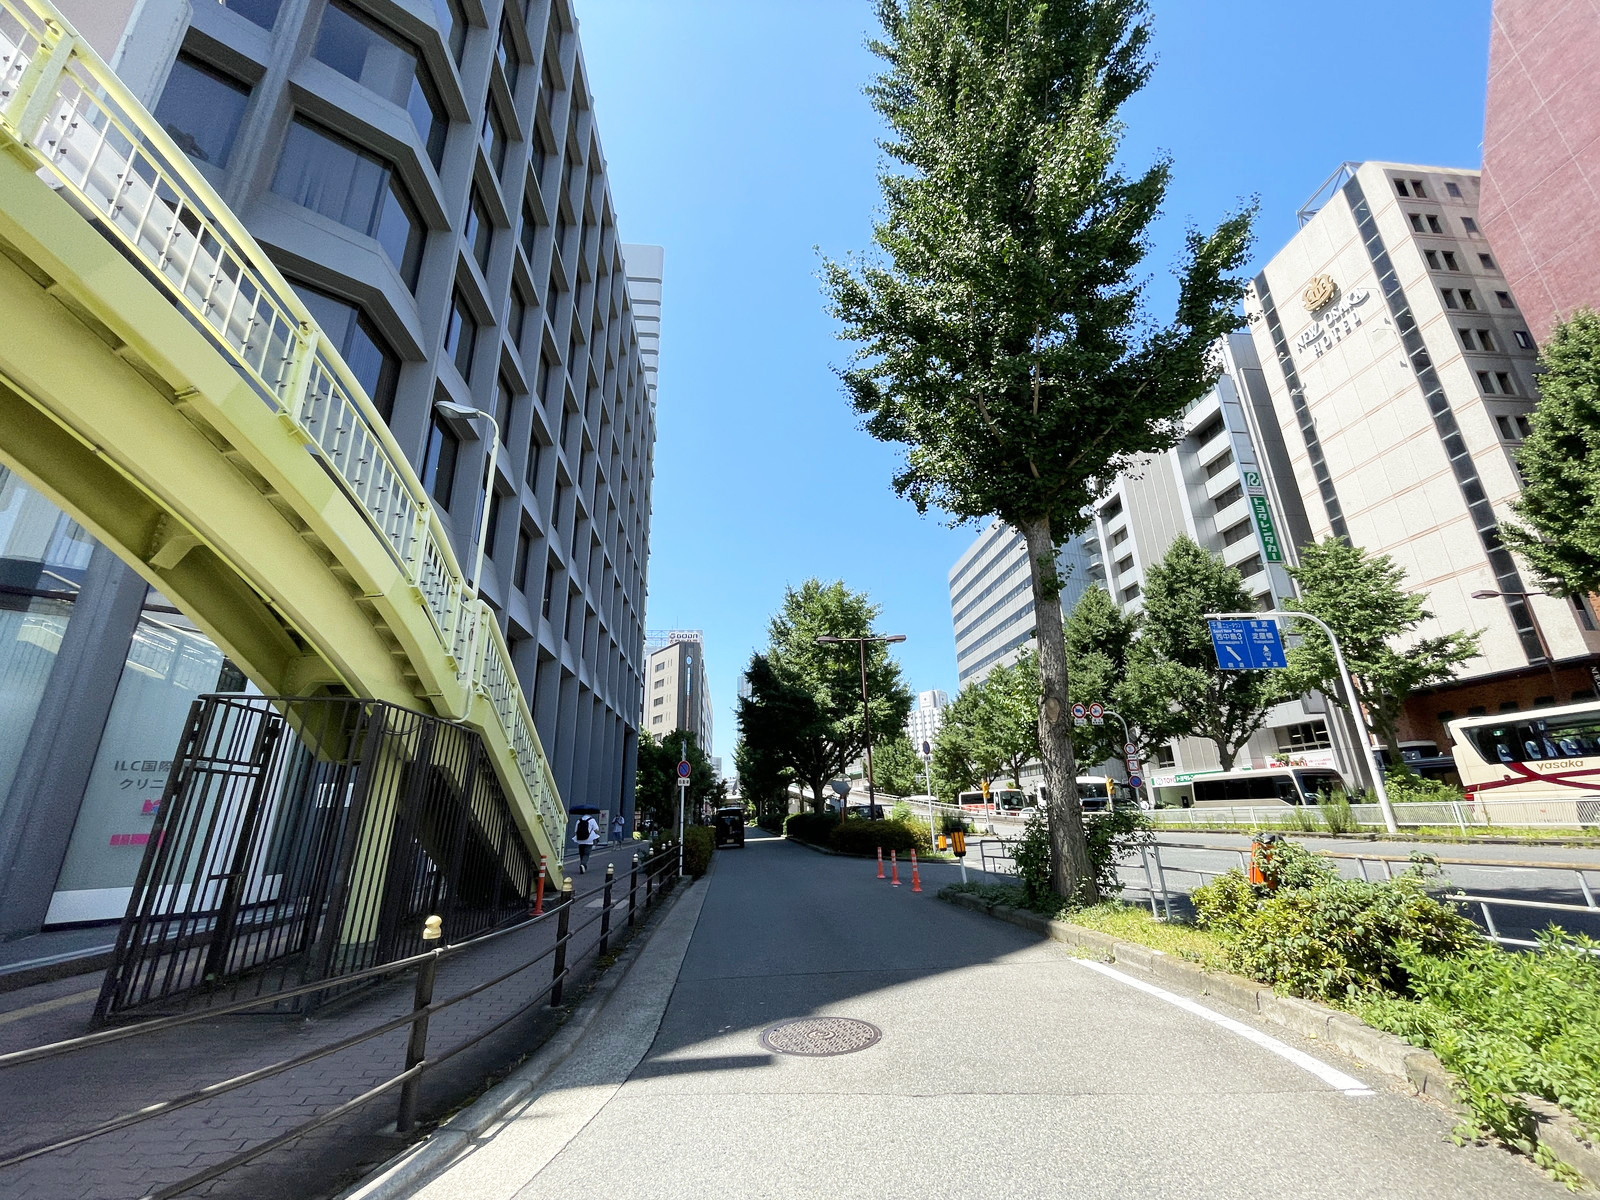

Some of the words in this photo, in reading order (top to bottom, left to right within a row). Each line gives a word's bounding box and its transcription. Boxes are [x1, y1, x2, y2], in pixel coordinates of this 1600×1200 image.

[1297, 321, 1325, 352] NEW
[1323, 288, 1370, 328] OSAKA
[1313, 311, 1361, 357] HOTEL
[1253, 497, 1278, 560] トヨタレンタカー
[1536, 760, 1584, 772] yasaka
